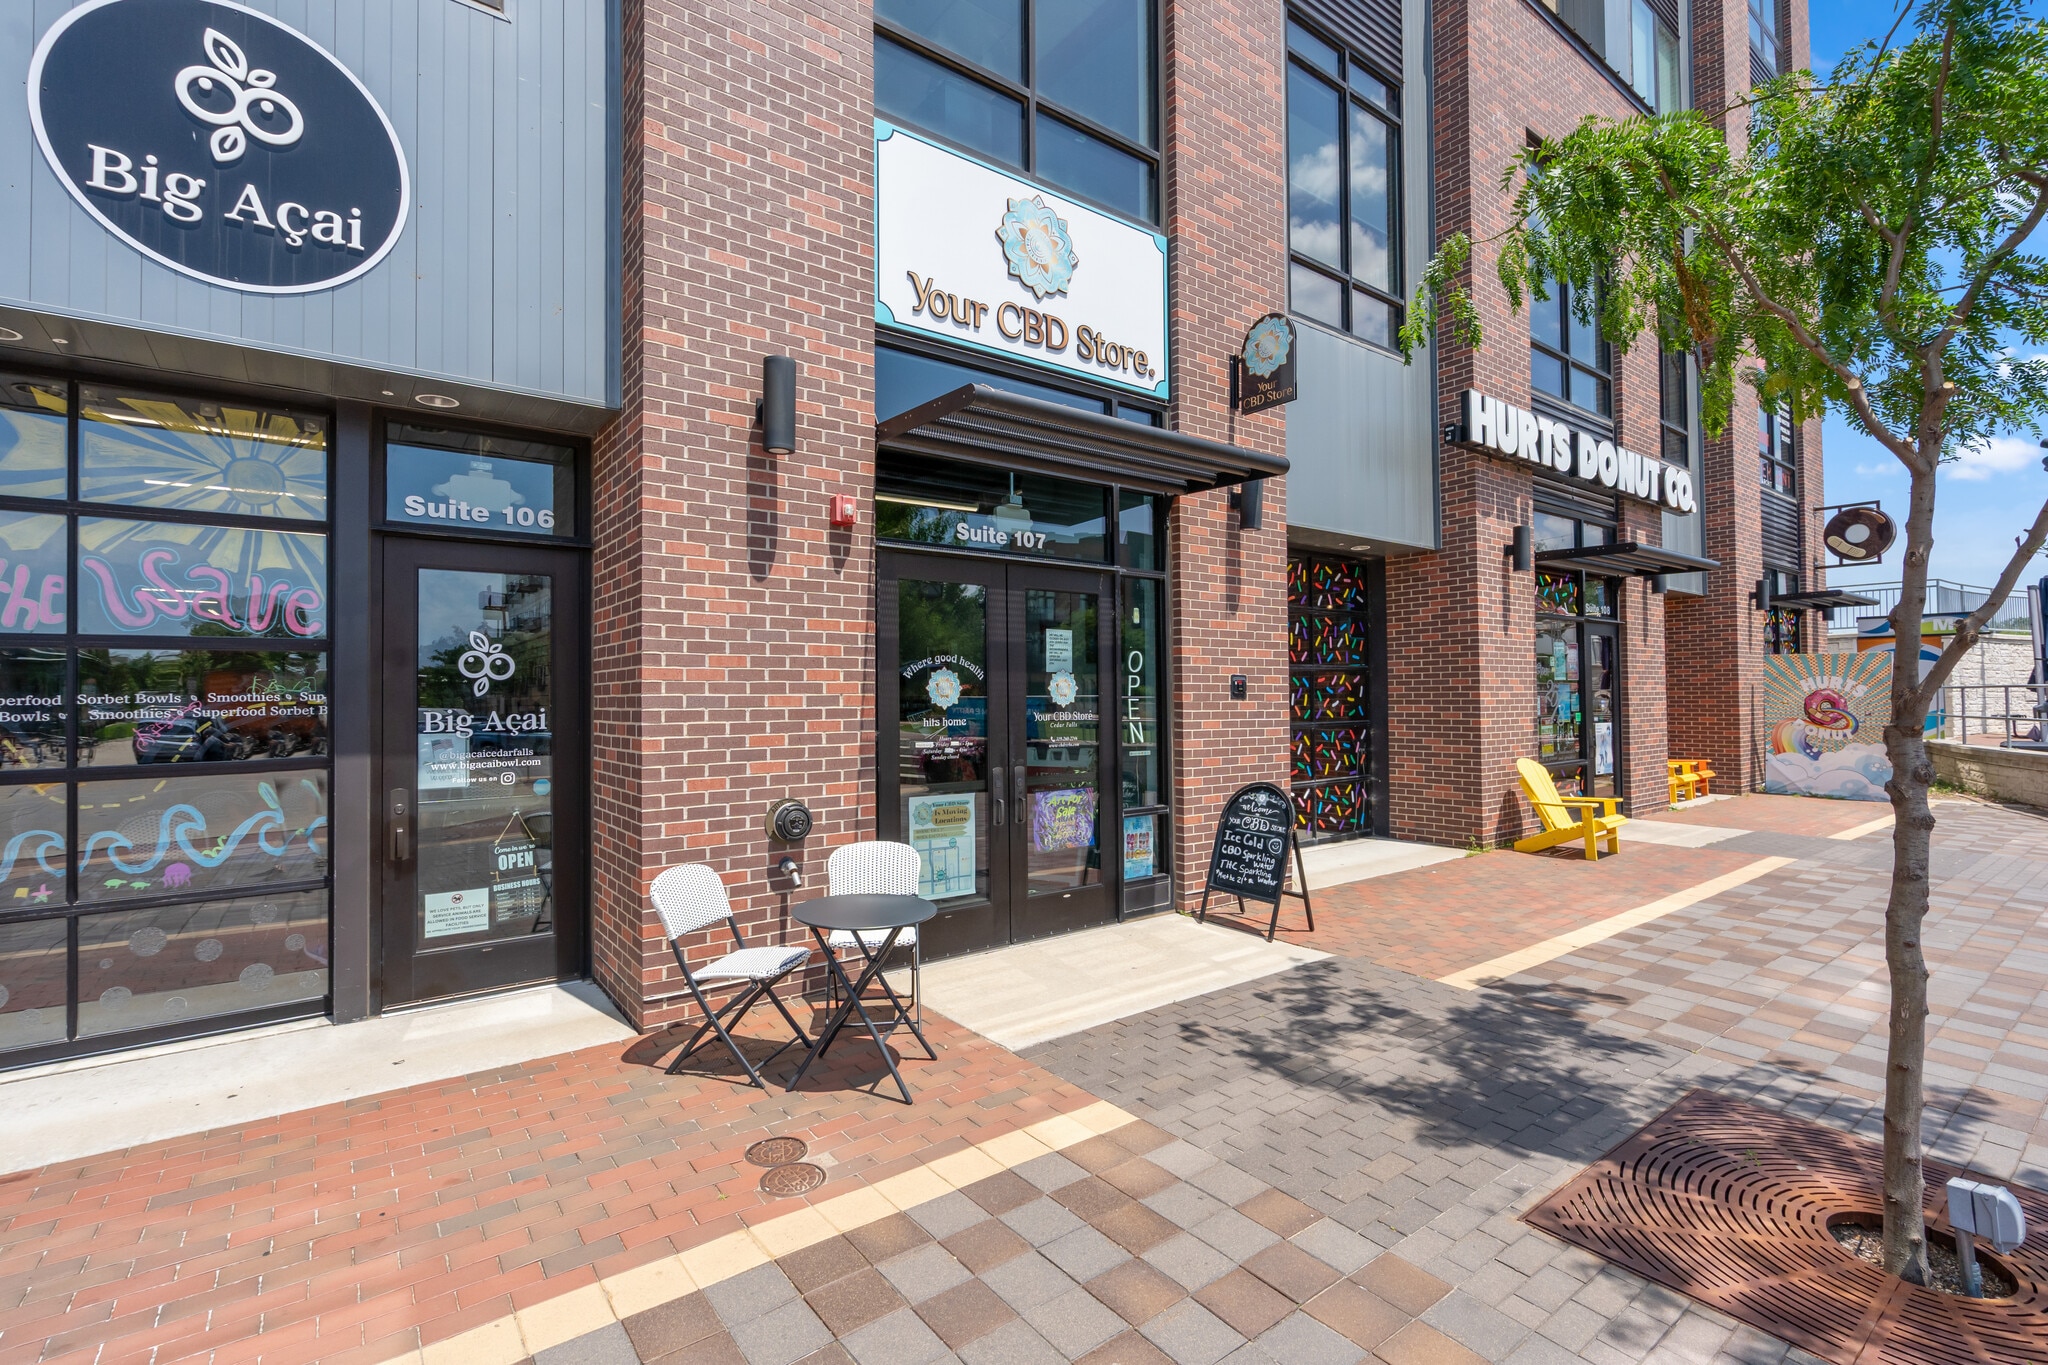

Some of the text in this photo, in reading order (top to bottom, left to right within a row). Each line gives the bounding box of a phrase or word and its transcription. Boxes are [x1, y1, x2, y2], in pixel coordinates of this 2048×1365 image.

[86, 144, 364, 251] Big Açai
[907, 270, 988, 328] Your
[997, 300, 1069, 350] CBD
[1257, 380, 1277, 393] Your
[1244, 387, 1292, 409] CBD Store
[1469, 388, 1697, 514] HURTS DONUT CO.
[404, 495, 555, 529] Suite 106
[956, 522, 1046, 549] Suite 107
[83, 551, 322, 636] Wave
[1585, 602, 1611, 615] Suite 108
[903, 654, 985, 681] Where good health
[1800, 675, 1868, 697] HURTS
[77, 693, 130, 705] Sorbet
[135, 693, 182, 704] Bowls
[207, 692, 281, 703] Smoothies
[1128, 650, 1144, 744] OPEN
[0, 711, 50, 722] Bowls
[89, 708, 171, 721] Smoothies
[193, 706, 266, 719] Superfood
[270, 705, 315, 716] Sorbet
[423, 708, 548, 738] Big Açai
[923, 717, 967, 728] hits home
[1033, 711, 1052, 722] Your
[1053, 711, 1071, 721] CBD
[439, 747, 534, 761] @bigacaicedarfalls
[430, 758, 541, 771] www.bigacaibowl.com
[452, 776, 478, 784] Follow
[935, 816, 967, 824] Locations
[942, 807, 968, 815] Moving
[1241, 816, 1270, 831] CBD
[1223, 829, 1264, 849] Ice Cold
[494, 846, 511, 855] Come
[1221, 844, 1276, 866] CBD Sparkling
[498, 851, 534, 871] OPEN
[1220, 859, 1272, 879] THC Sparkling
[493, 878, 541, 892] BUSINESS HOURS
